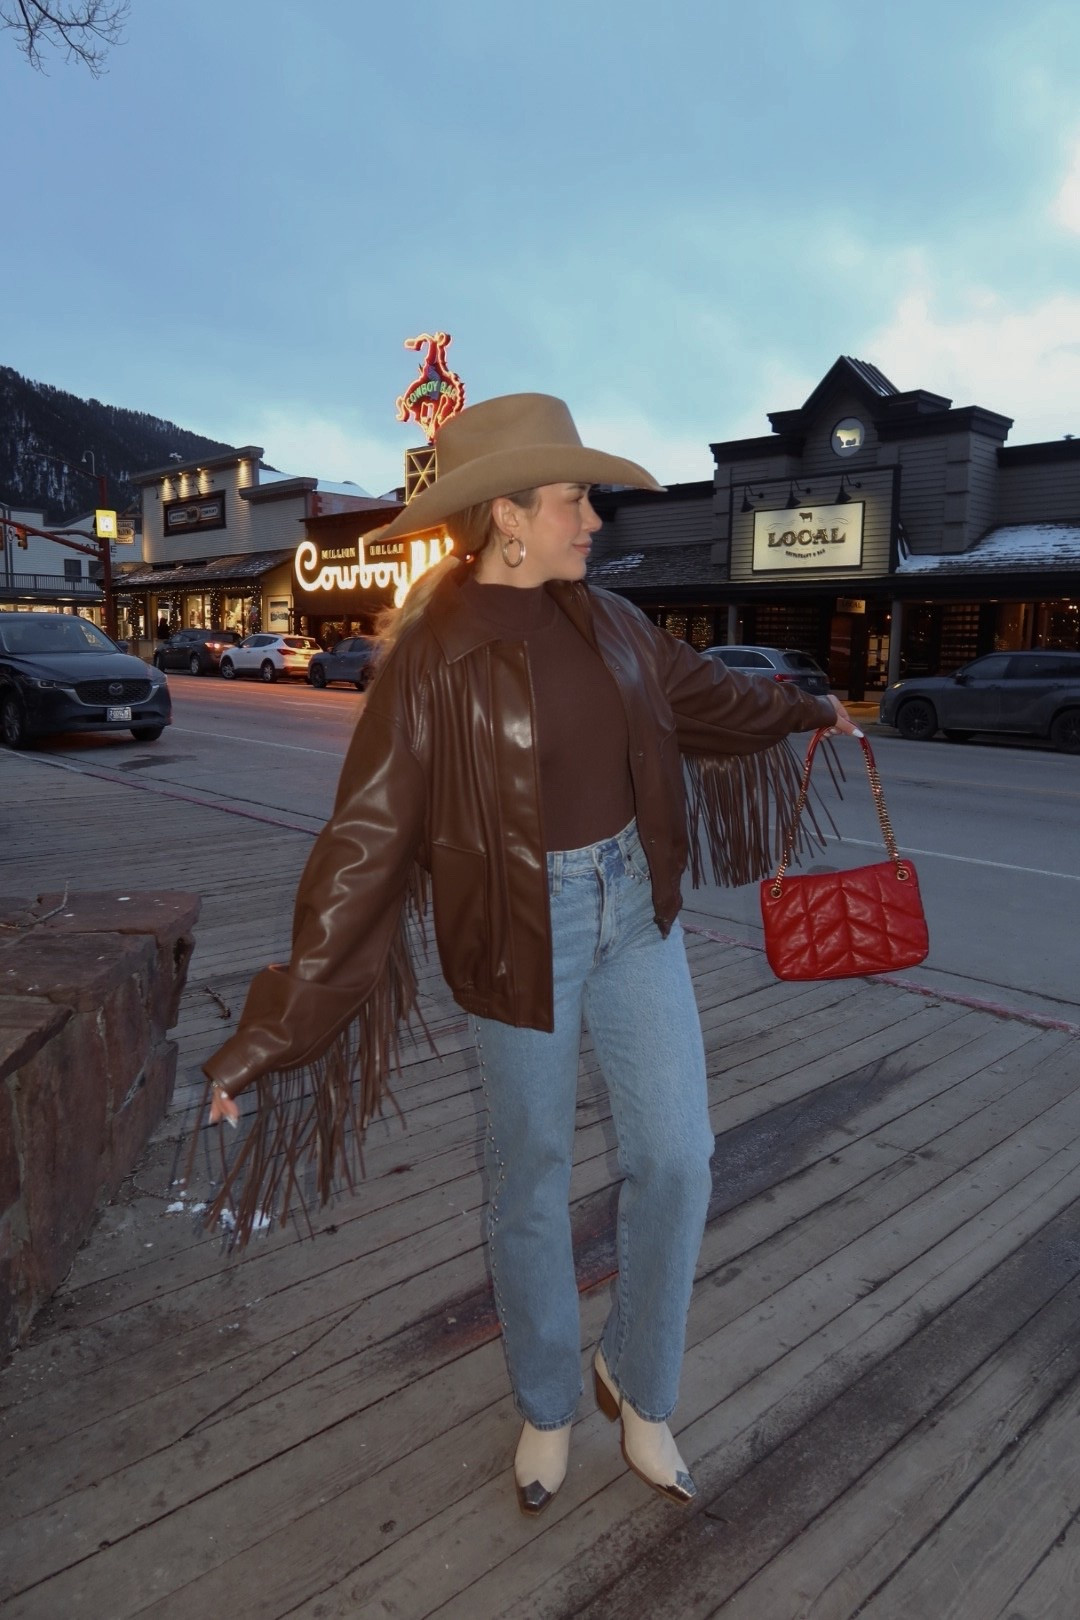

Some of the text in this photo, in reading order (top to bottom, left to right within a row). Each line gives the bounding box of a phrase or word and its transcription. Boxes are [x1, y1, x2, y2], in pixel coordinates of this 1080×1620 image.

[406, 380, 457, 407] COWBOY BAR
[768, 528, 846, 547] LOCAL
[321, 543, 404, 560] MILLION DOLLAR
[294, 537, 406, 608] Cowboy
